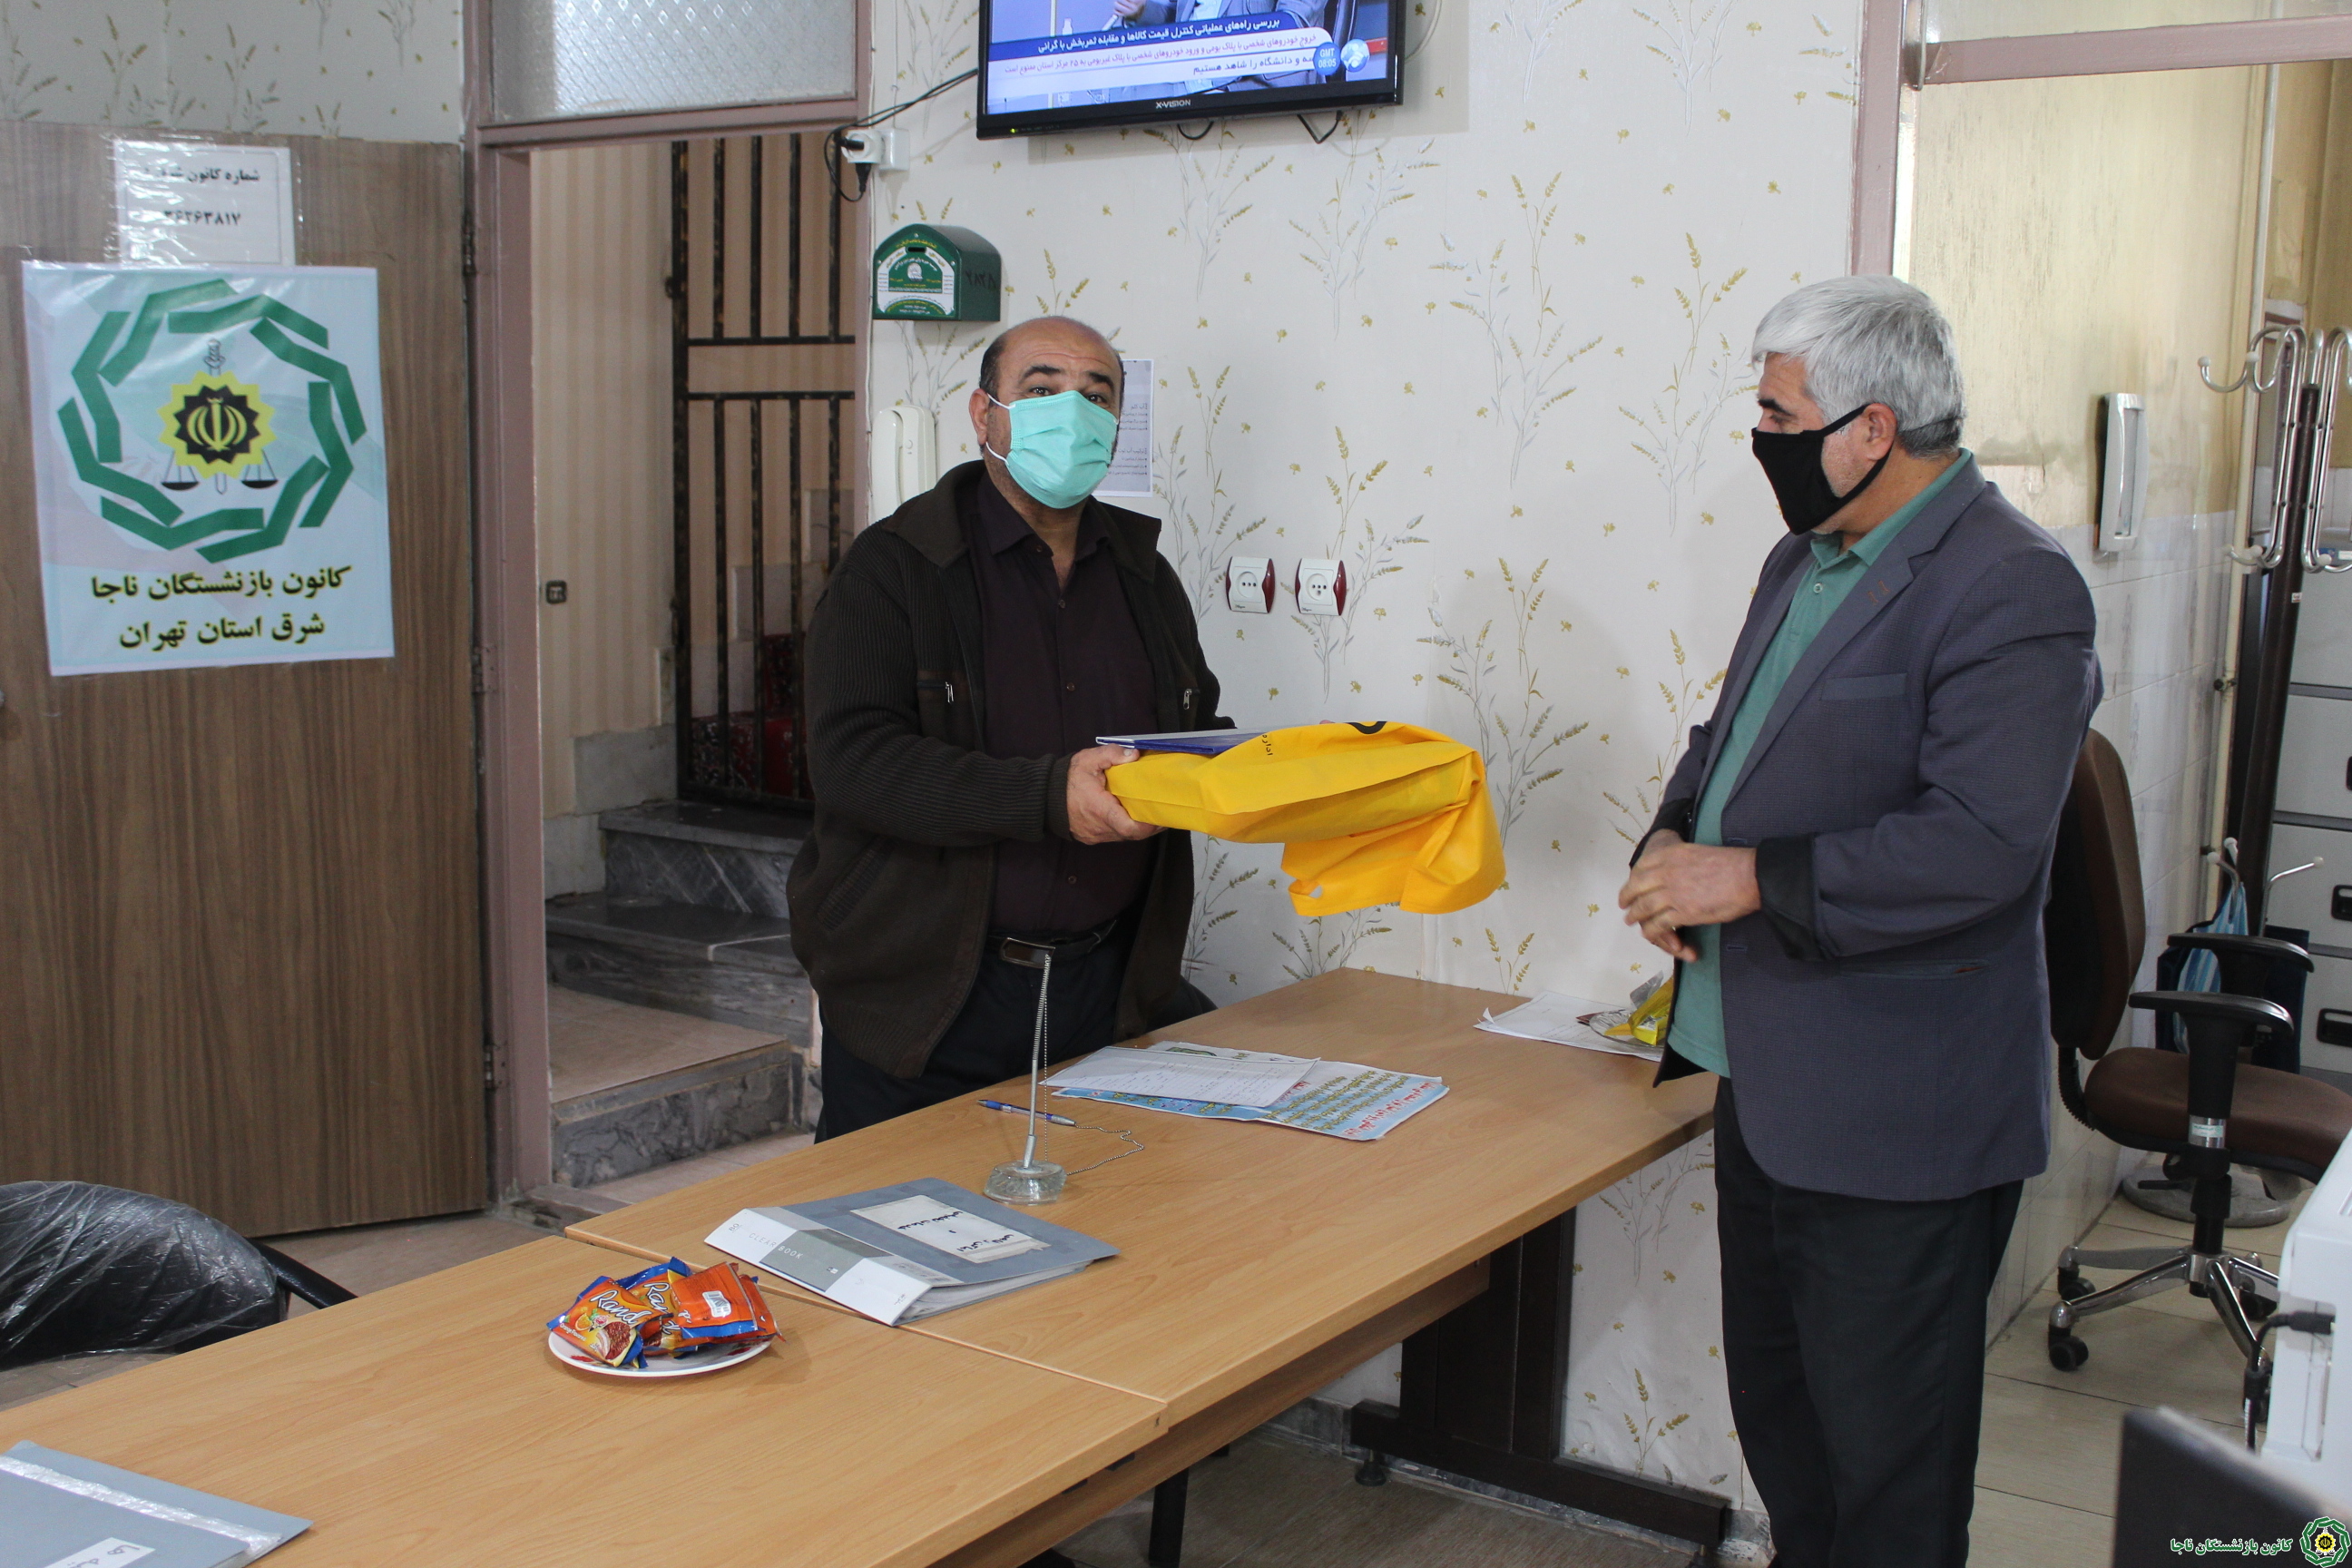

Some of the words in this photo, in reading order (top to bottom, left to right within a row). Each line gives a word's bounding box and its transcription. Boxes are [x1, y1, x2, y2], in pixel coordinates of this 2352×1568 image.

[1195, 23, 1223, 35] عملیاتی
[1253, 19, 1280, 30] بررسی
[1127, 30, 1147, 42] کالاها
[1148, 28, 1170, 40] قیمت
[1171, 25, 1194, 38] کنترل
[1060, 39, 1065, 51] با
[1098, 34, 1120, 45] مقابله
[1038, 39, 1059, 53] گرانی
[1319, 48, 1335, 57] GMT
[1225, 60, 1247, 70] شاهد
[1250, 59, 1257, 70] را
[1260, 55, 1293, 67] دانشگاه
[1318, 59, 1337, 68] 08:05
[1193, 64, 1222, 75] هستیم
[187, 167, 221, 183] کانون
[224, 170, 260, 184] شماره
[148, 569, 273, 600] بازنشستگان
[282, 565, 351, 598] کانون
[92, 574, 138, 603] ناجا
[197, 616, 261, 644] استان
[271, 612, 325, 643] شرق
[119, 620, 187, 652] تهران
[749, 1232, 778, 1248] CLEAR
[778, 1245, 804, 1260] BOOK
